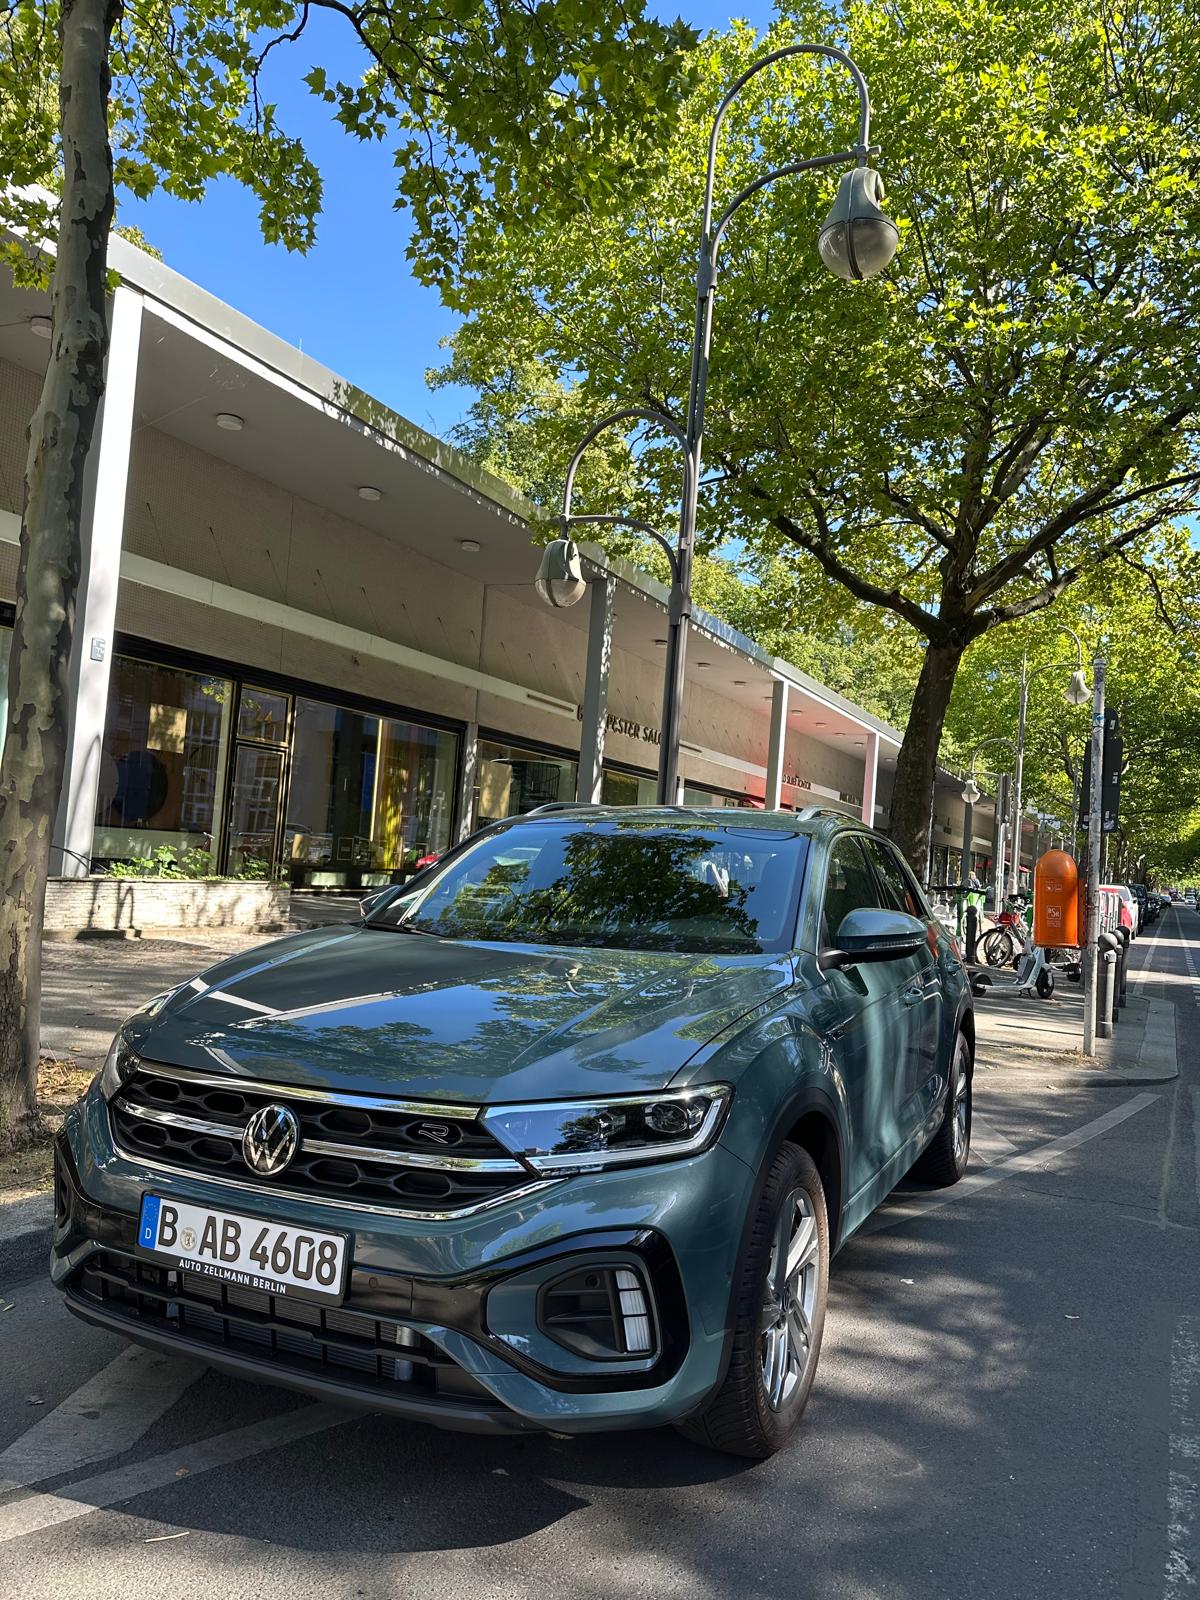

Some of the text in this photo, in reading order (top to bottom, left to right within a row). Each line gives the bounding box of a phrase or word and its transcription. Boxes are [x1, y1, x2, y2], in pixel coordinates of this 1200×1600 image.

[145, 1228, 152, 1239] D
[158, 1205, 338, 1286] B AB 4608
[179, 1259, 287, 1294] AUTO ZELLMANN BERLIN
